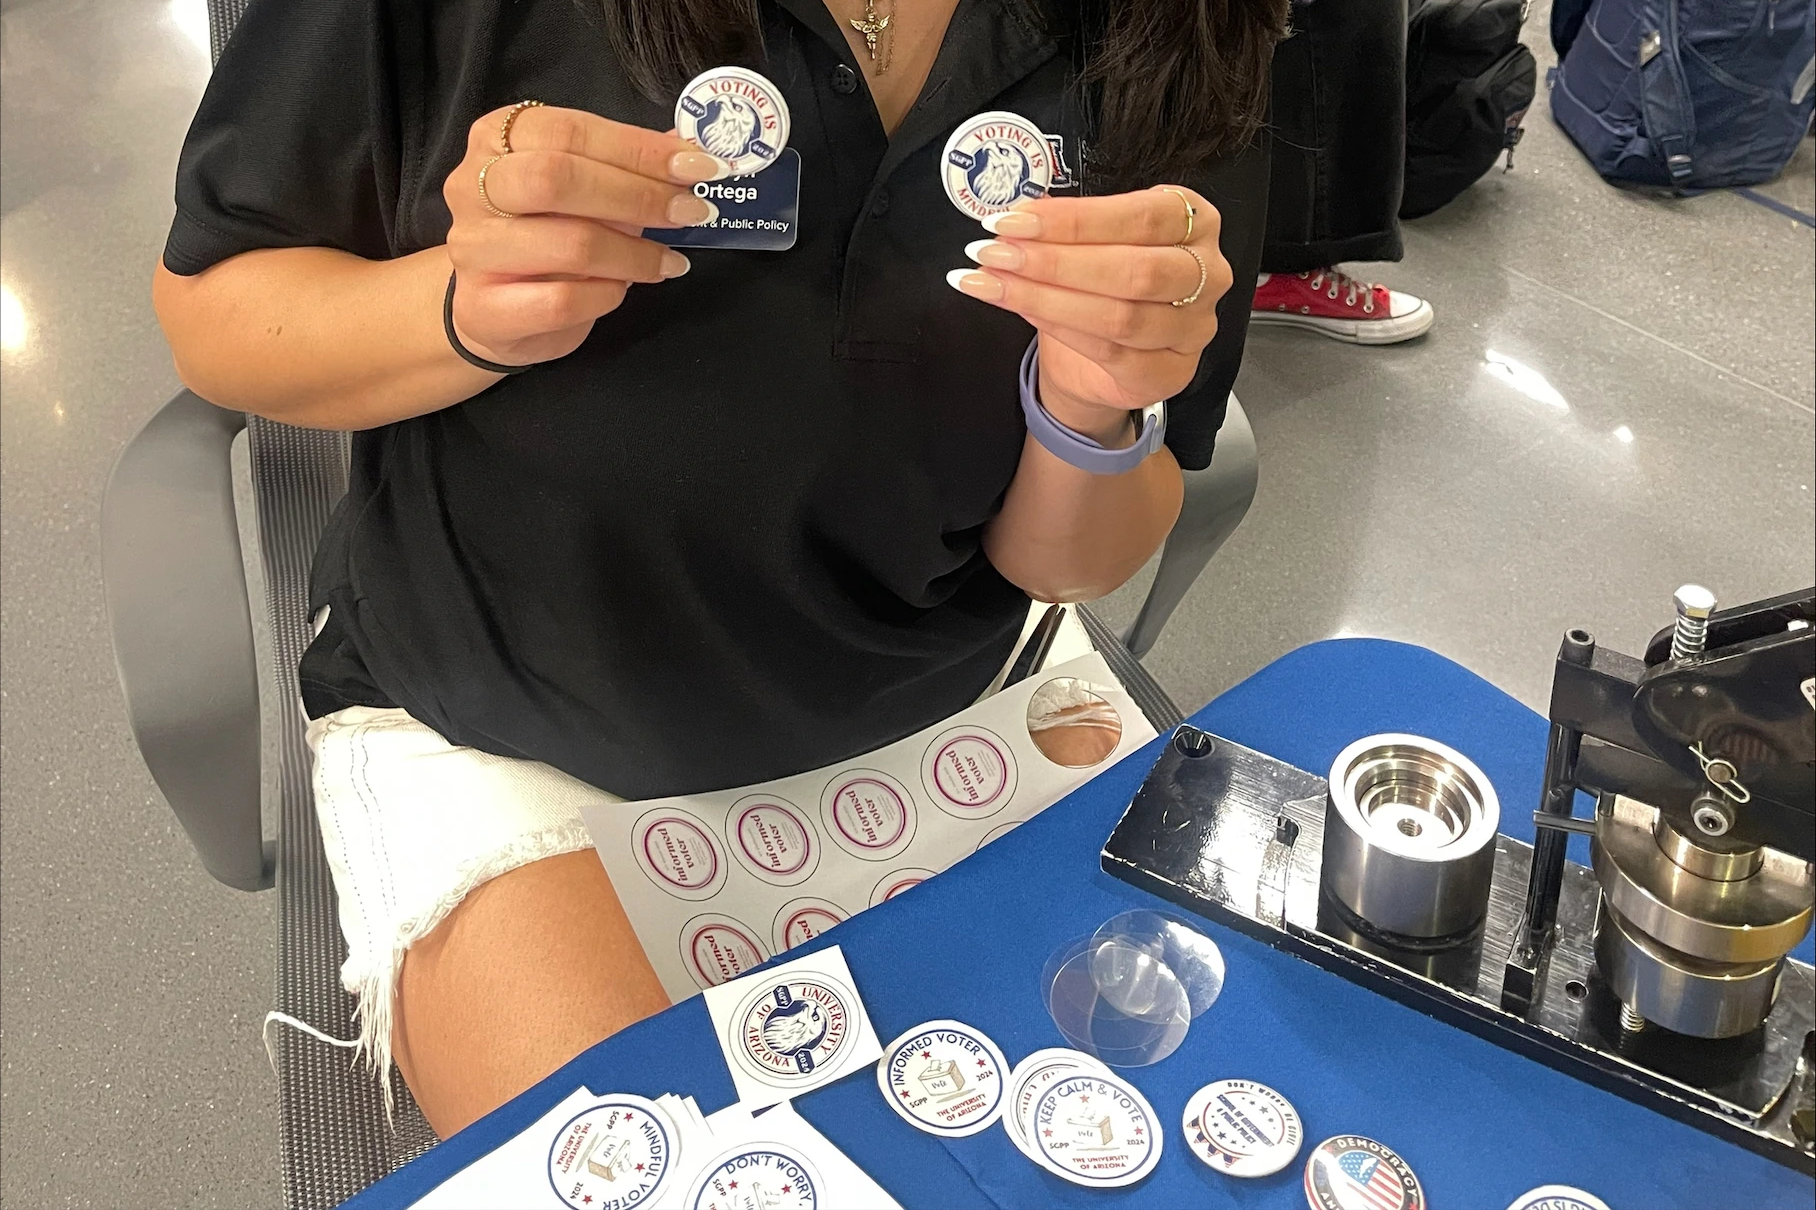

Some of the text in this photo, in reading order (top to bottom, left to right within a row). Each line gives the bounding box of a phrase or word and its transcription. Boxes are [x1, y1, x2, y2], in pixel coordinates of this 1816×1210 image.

[709, 80, 777, 130] VOTING IS
[973, 125, 1044, 169] VOTING IS
[693, 182, 758, 204] Ortega
[721, 218, 755, 230] Public
[756, 219, 789, 233] Policy
[946, 750, 979, 802] informed
[964, 756, 985, 784] voter
[845, 790, 878, 843] informed
[865, 798, 884, 827] voter
[676, 837, 695, 868] voter
[750, 814, 781, 867] informed
[769, 823, 787, 853] voter
[657, 828, 688, 881] informed
[748, 1004, 790, 1067] OF ARIZONA
[802, 987, 842, 1055] UNIVERSITY
[798, 1053, 811, 1073] 2024
[893, 1033, 981, 1086] INFORMED VOTER
[976, 1070, 994, 1082] 2024
[1227, 1082, 1254, 1090] DON'T
[909, 1097, 928, 1109] SGPP
[936, 1093, 987, 1118] THE UNIVERSITY
[946, 1101, 987, 1122] OF ARIZONA
[1039, 1096, 1058, 1125] KEEP
[1057, 1081, 1093, 1098] CALM
[1097, 1083, 1107, 1095] &
[1112, 1090, 1143, 1123] VOTE
[1216, 1094, 1275, 1148] SCHOOL OF GOVERNMENT
[1220, 1111, 1241, 1129] PUBLIC
[1237, 1126, 1257, 1144] POLICY
[556, 1124, 582, 1165] OF ARIZONA
[561, 1122, 592, 1174] THE UNIVERSITY
[1087, 1155, 1130, 1163] UNIVERSITY
[603, 1120, 662, 1210] MINDFUL VOTER
[724, 1154, 773, 1175] DON'T
[1093, 1162, 1126, 1170] ARIZONA
[1336, 1137, 1418, 1197] DEMOCRACY
[570, 1182, 584, 1200] 2024
